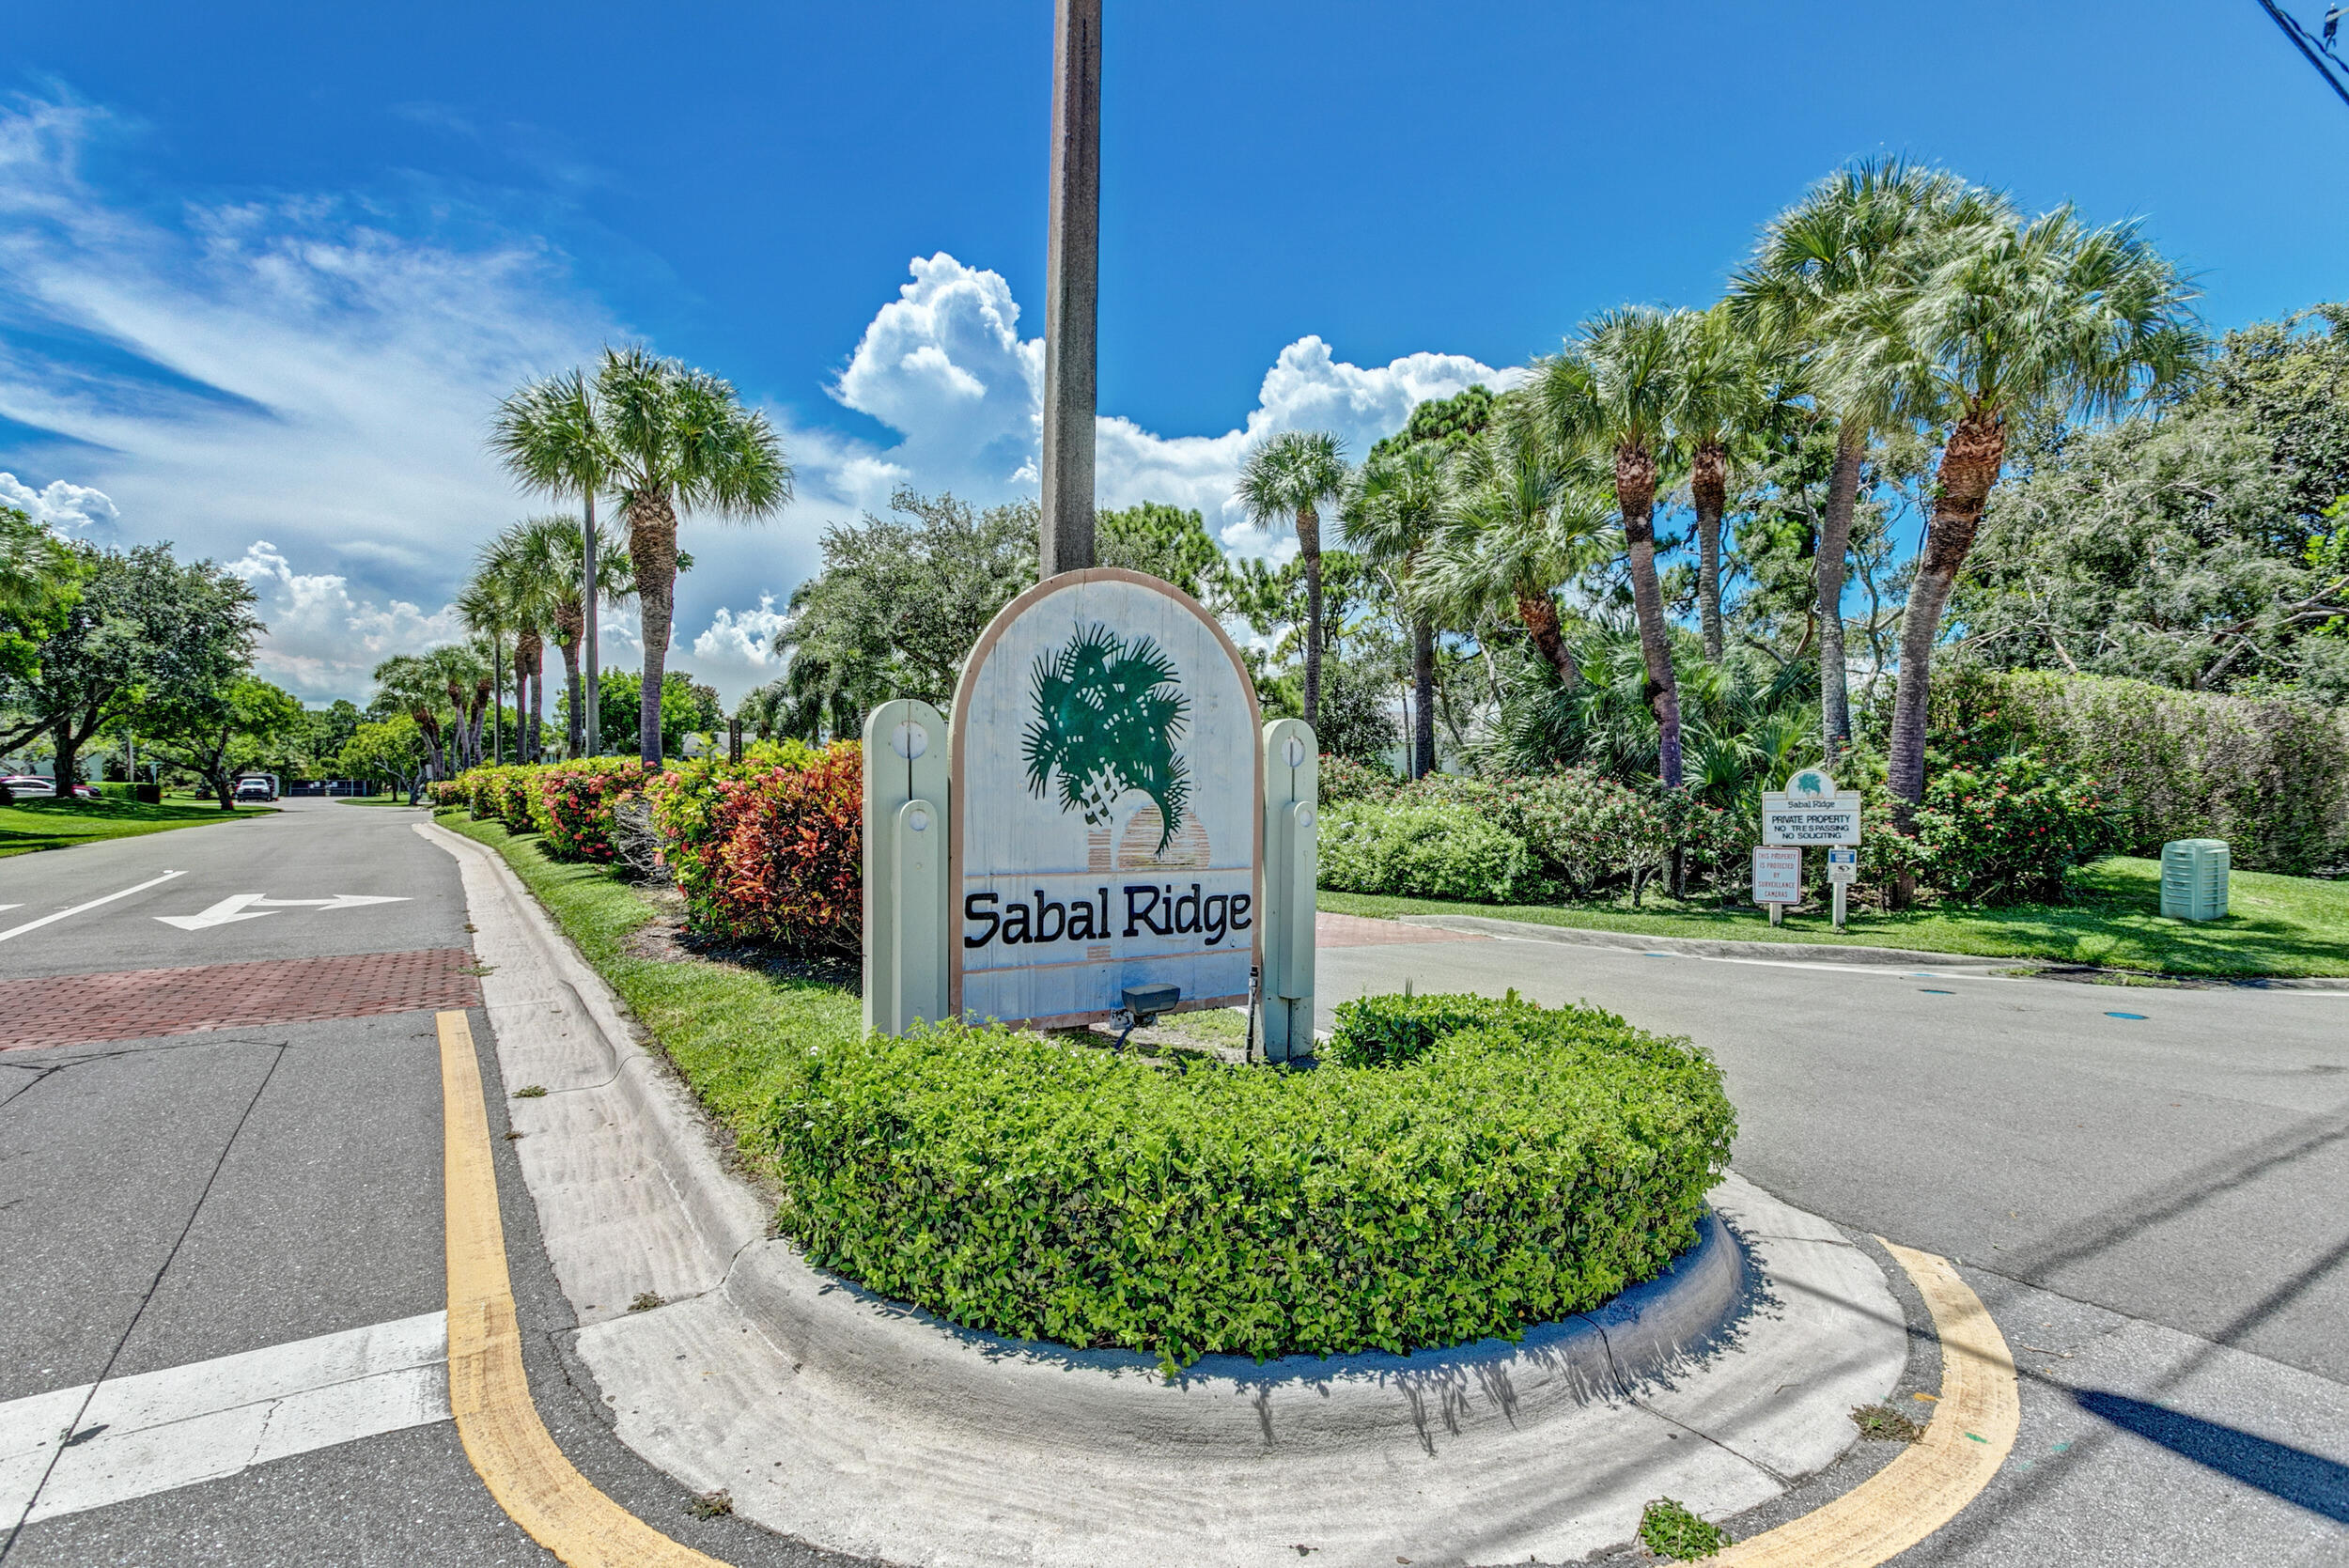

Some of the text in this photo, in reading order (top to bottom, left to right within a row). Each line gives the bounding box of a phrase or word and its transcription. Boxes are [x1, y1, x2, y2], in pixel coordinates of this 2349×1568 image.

[1788, 800, 1835, 810] Sabal Ridge
[1772, 815, 1851, 824] PRIVATE PROPERTY
[964, 883, 1252, 948] Sabal Ridge
